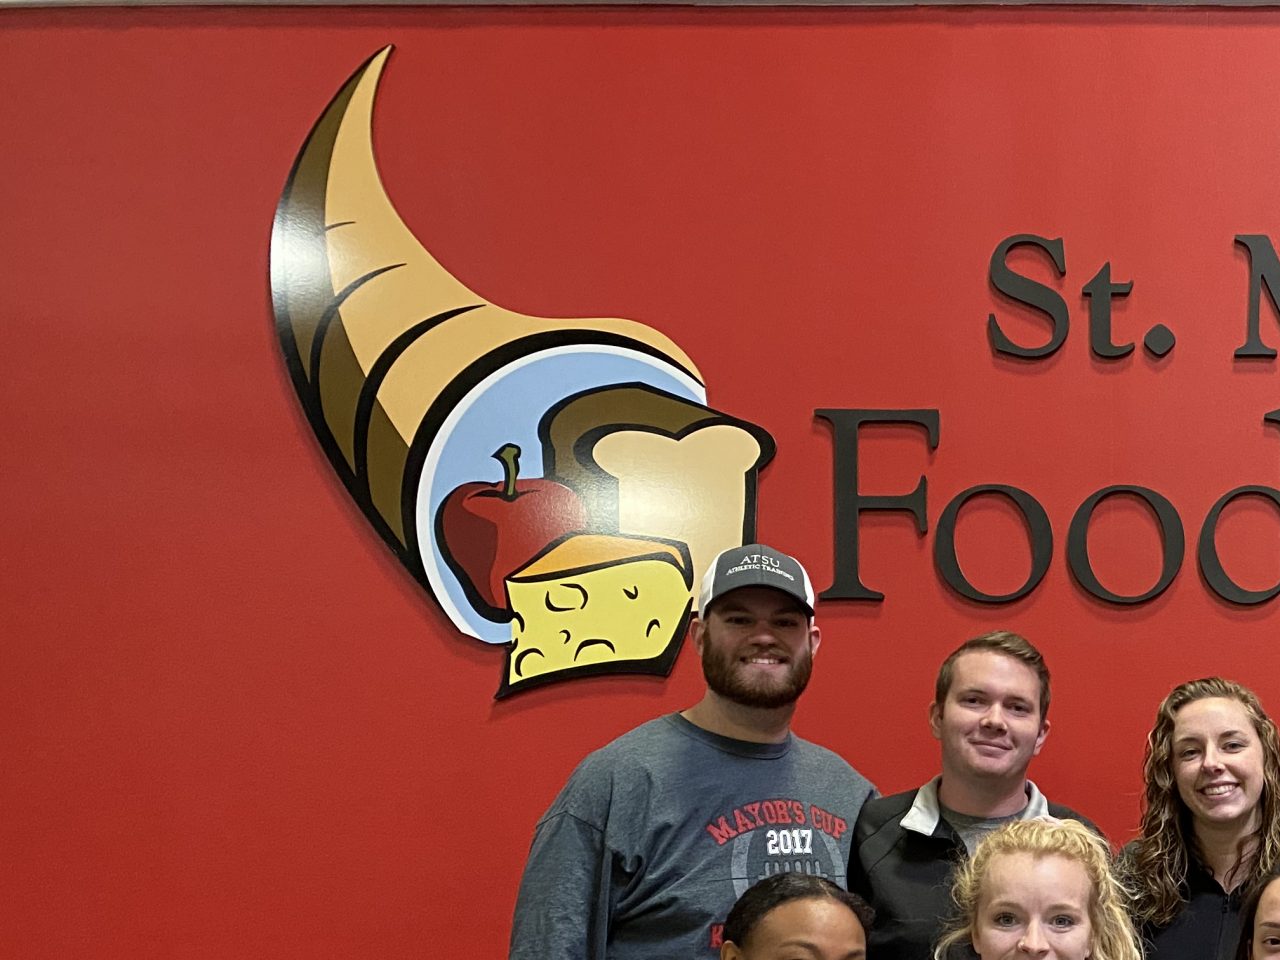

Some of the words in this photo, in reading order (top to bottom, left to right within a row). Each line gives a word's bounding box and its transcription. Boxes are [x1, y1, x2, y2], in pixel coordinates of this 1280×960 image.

[987, 233, 1176, 360] St.
[740, 554, 780, 568] ATSU
[706, 798, 807, 846] MAYOR'S
[809, 803, 848, 840] CUP
[766, 829, 813, 856] 2017
